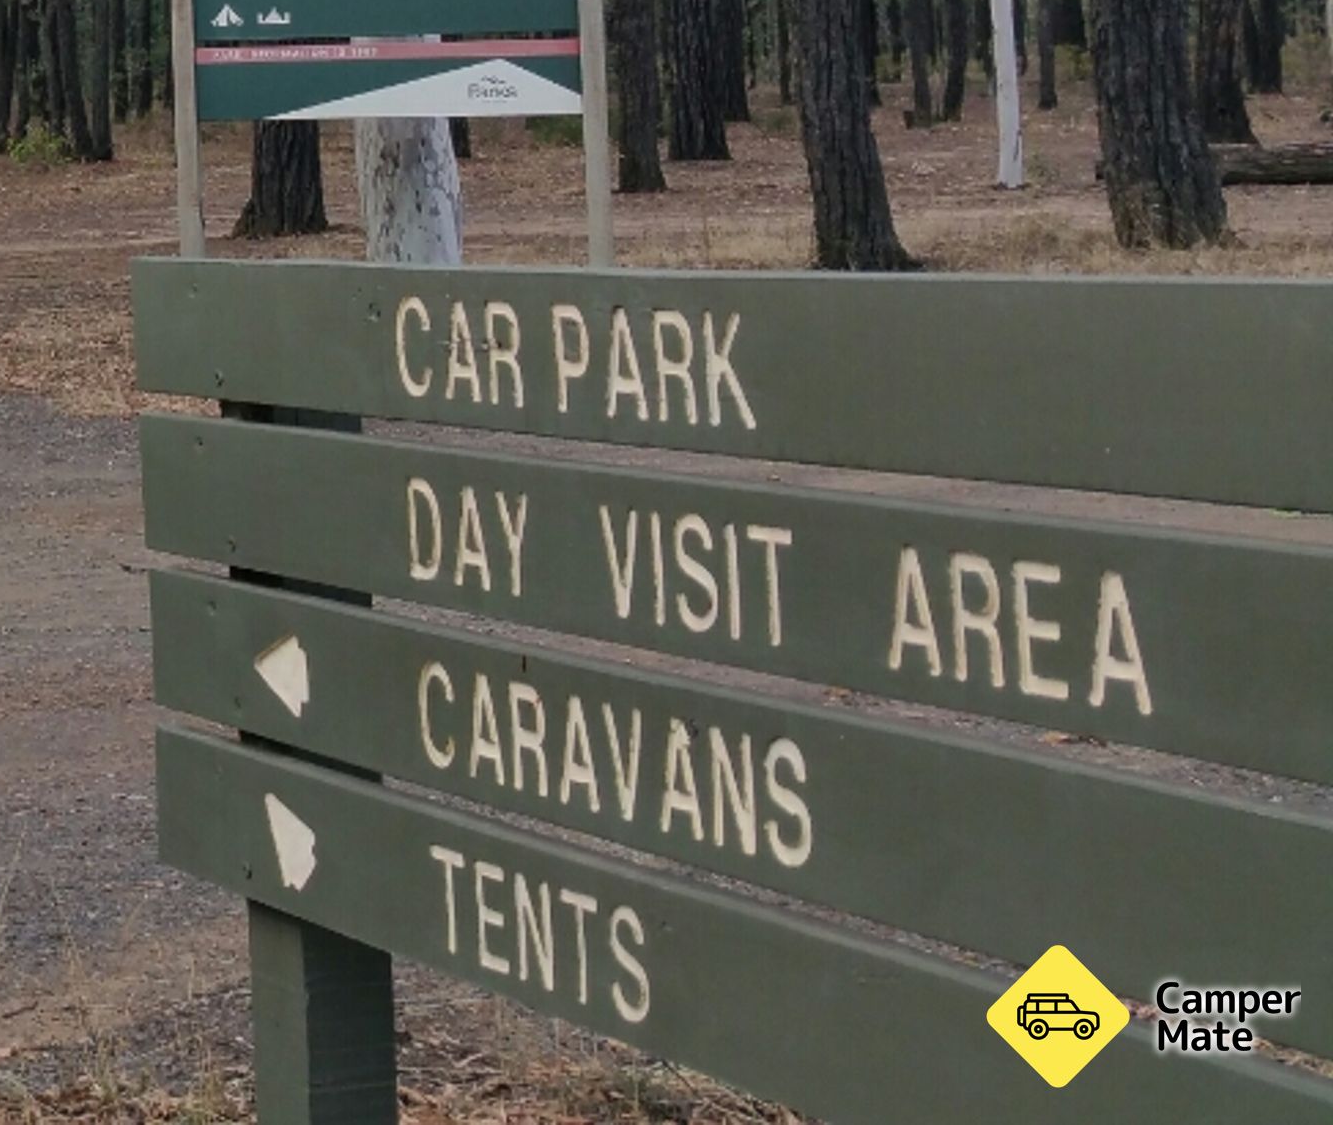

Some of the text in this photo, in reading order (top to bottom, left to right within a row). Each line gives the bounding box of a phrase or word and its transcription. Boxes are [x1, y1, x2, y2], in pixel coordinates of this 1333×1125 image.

[396, 296, 757, 430] CAR PARK
[407, 478, 1153, 717] DAY VISIT AREA
[418, 663, 813, 867] CARAVANS
[430, 845, 651, 1024] TENTS
